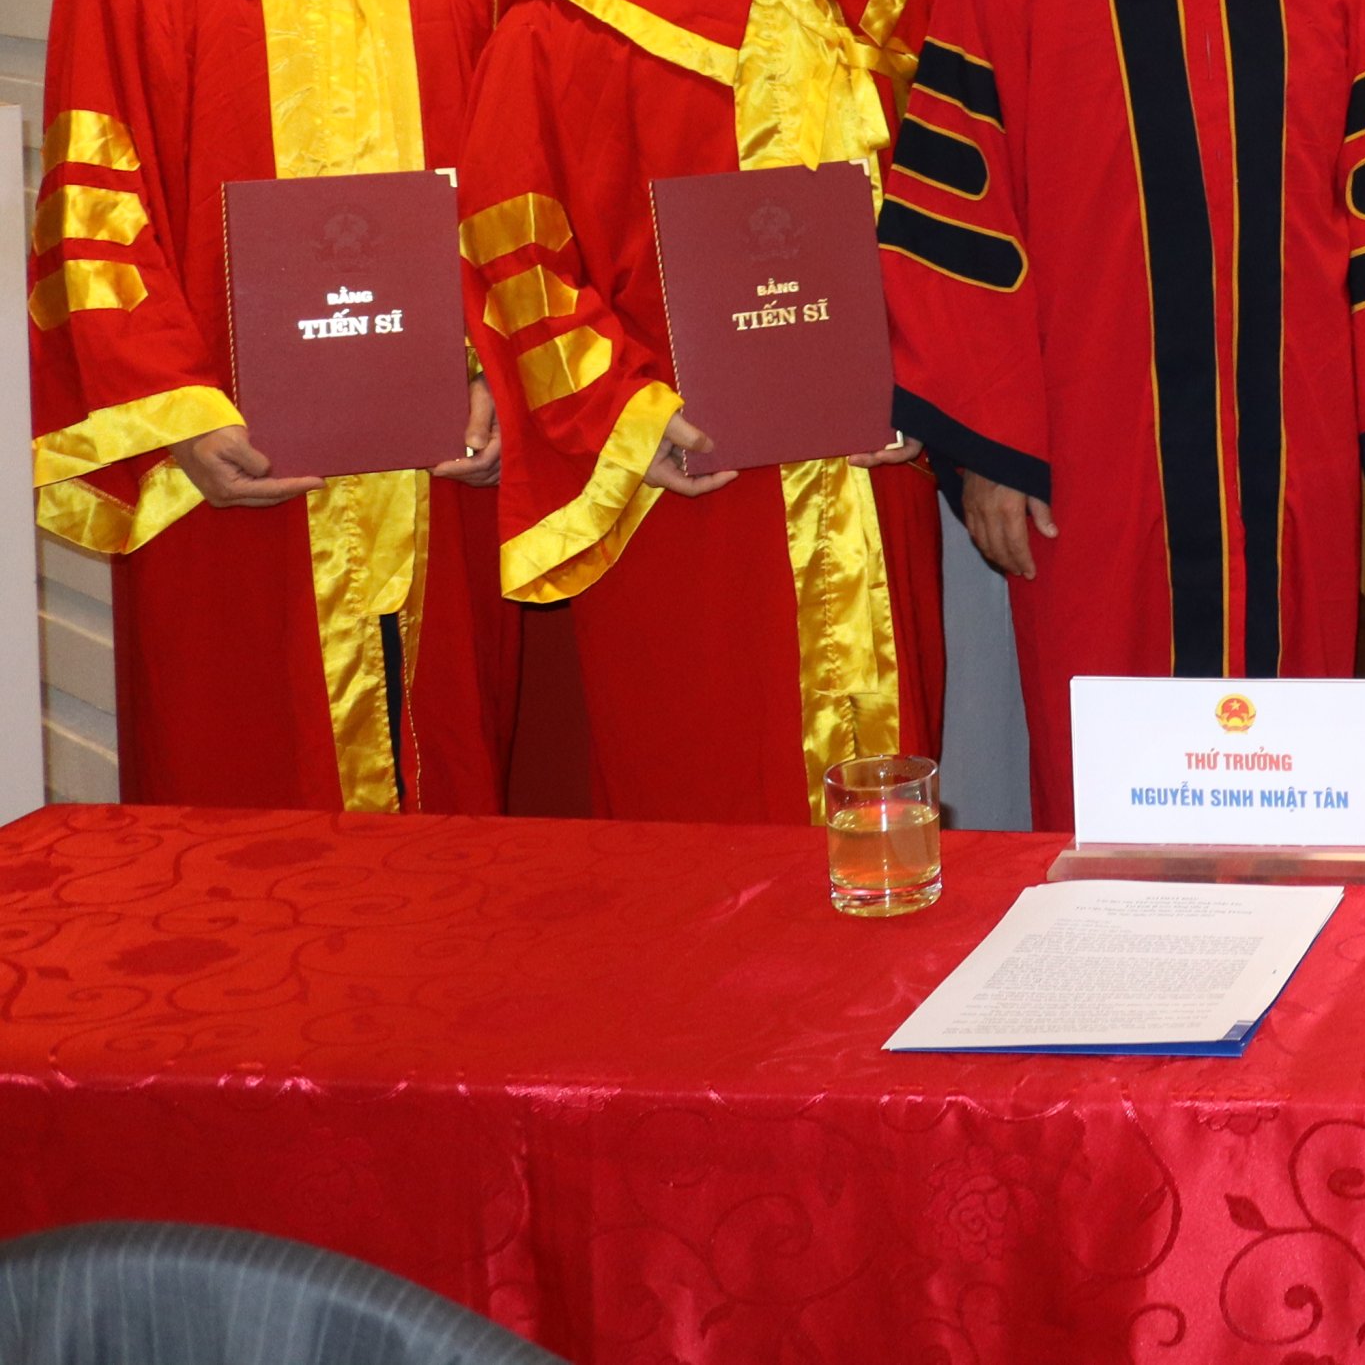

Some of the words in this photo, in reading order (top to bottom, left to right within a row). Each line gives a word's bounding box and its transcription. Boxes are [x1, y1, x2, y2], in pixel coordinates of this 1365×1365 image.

[327, 286, 373, 305] BẰNG
[757, 278, 799, 296] BẰNG
[298, 309, 368, 339] TIẾN
[375, 310, 403, 334] SĨ
[732, 300, 796, 330] TIẾN
[803, 298, 829, 322] SĨ
[1185, 748, 1219, 770] THỨ
[1223, 747, 1292, 771] TRƯỞNG
[1131, 782, 1203, 806] NGUYỄN
[1211, 789, 1253, 807] SINH
[1260, 787, 1307, 812] NHẬT
[1313, 787, 1348, 808] TÂN
